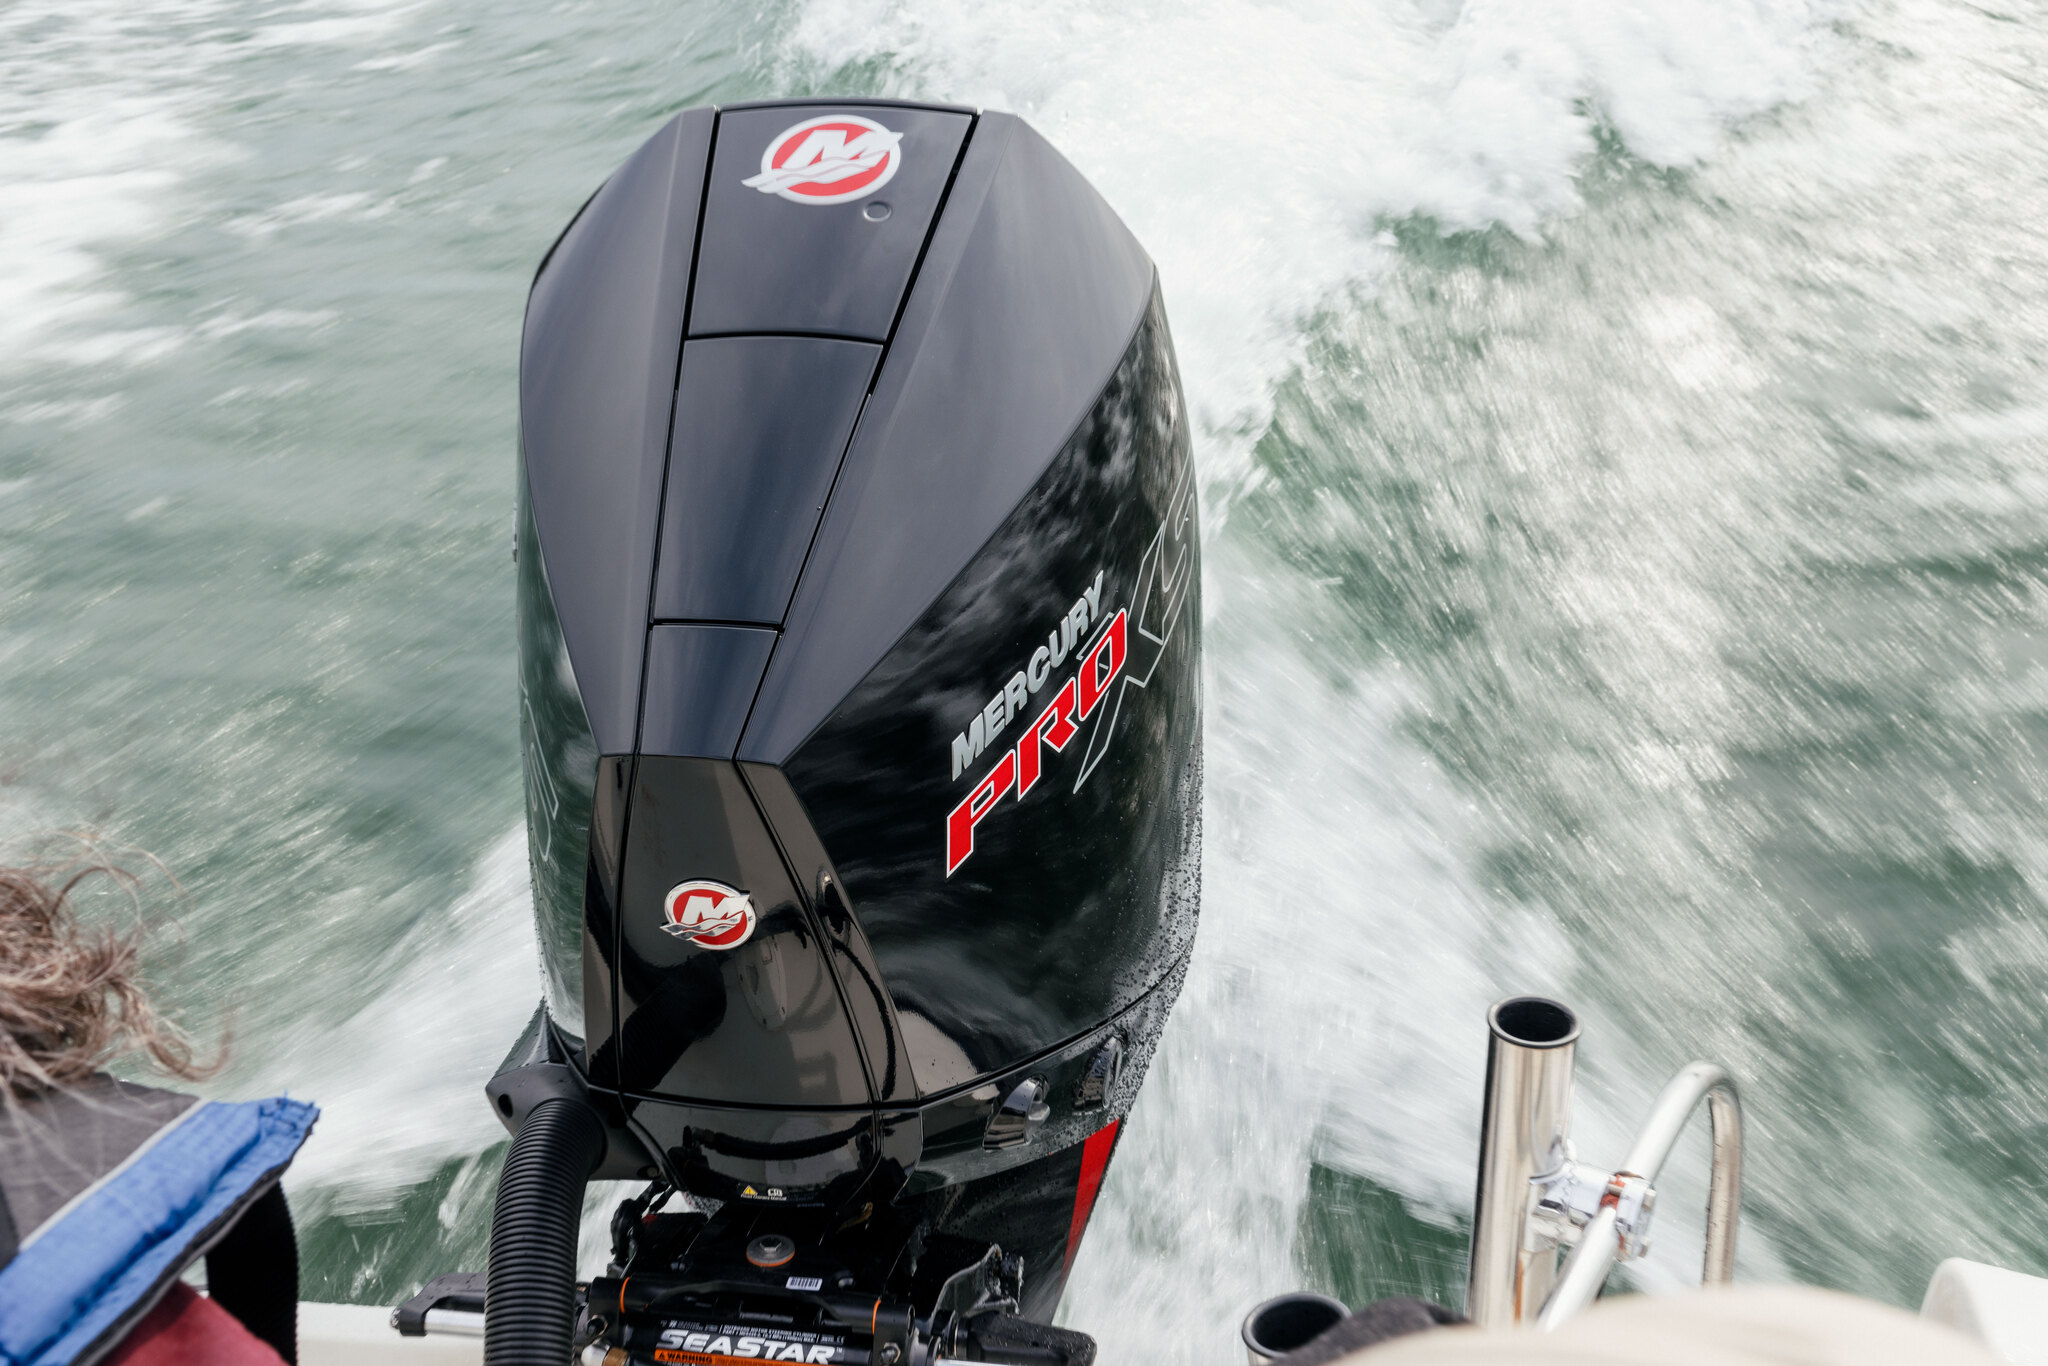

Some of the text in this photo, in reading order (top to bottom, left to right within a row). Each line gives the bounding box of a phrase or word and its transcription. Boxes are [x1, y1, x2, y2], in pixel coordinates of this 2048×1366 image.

[952, 570, 1104, 781] MERCURY
[946, 608, 1128, 878] PRO
[656, 1329, 835, 1365] SEASTAR
[667, 1352, 713, 1365] WARNING
